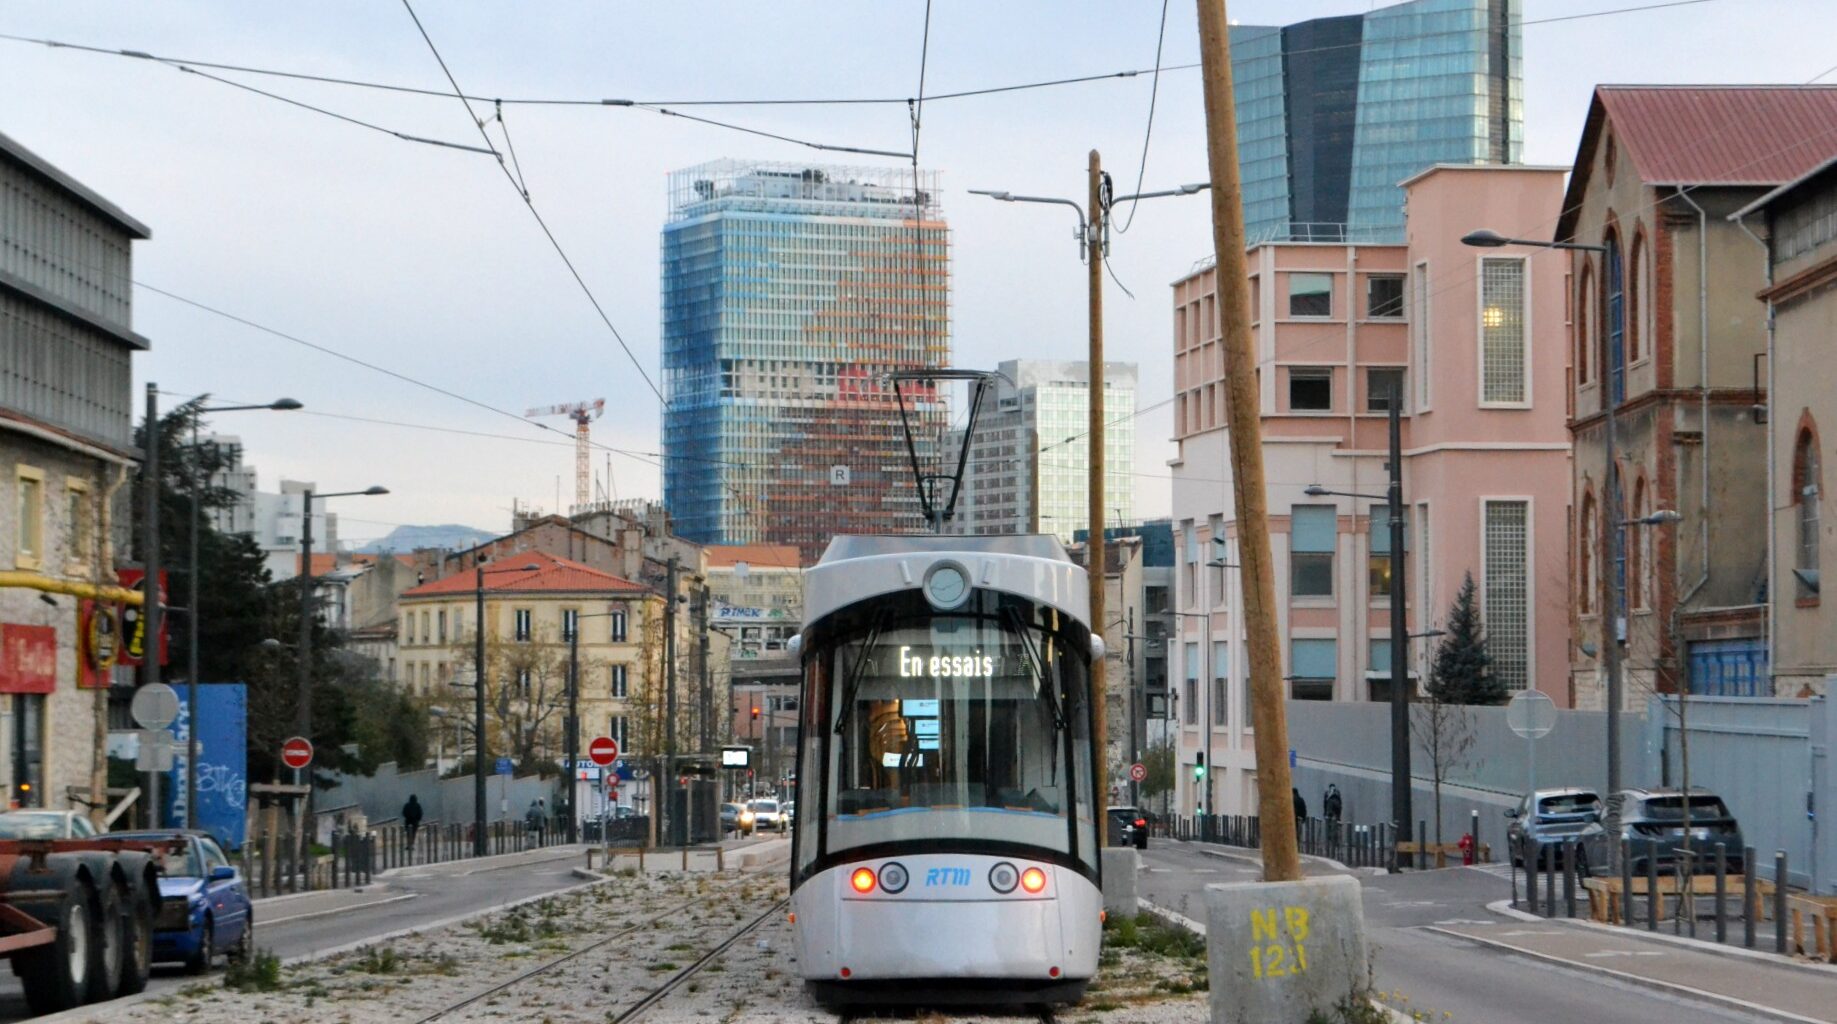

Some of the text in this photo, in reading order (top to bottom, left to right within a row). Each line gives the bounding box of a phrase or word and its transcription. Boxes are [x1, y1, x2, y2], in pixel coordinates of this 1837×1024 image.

[835, 469, 845, 480] R
[900, 646, 922, 677] En
[929, 649, 993, 677] essais
[926, 867, 971, 887] RTM
